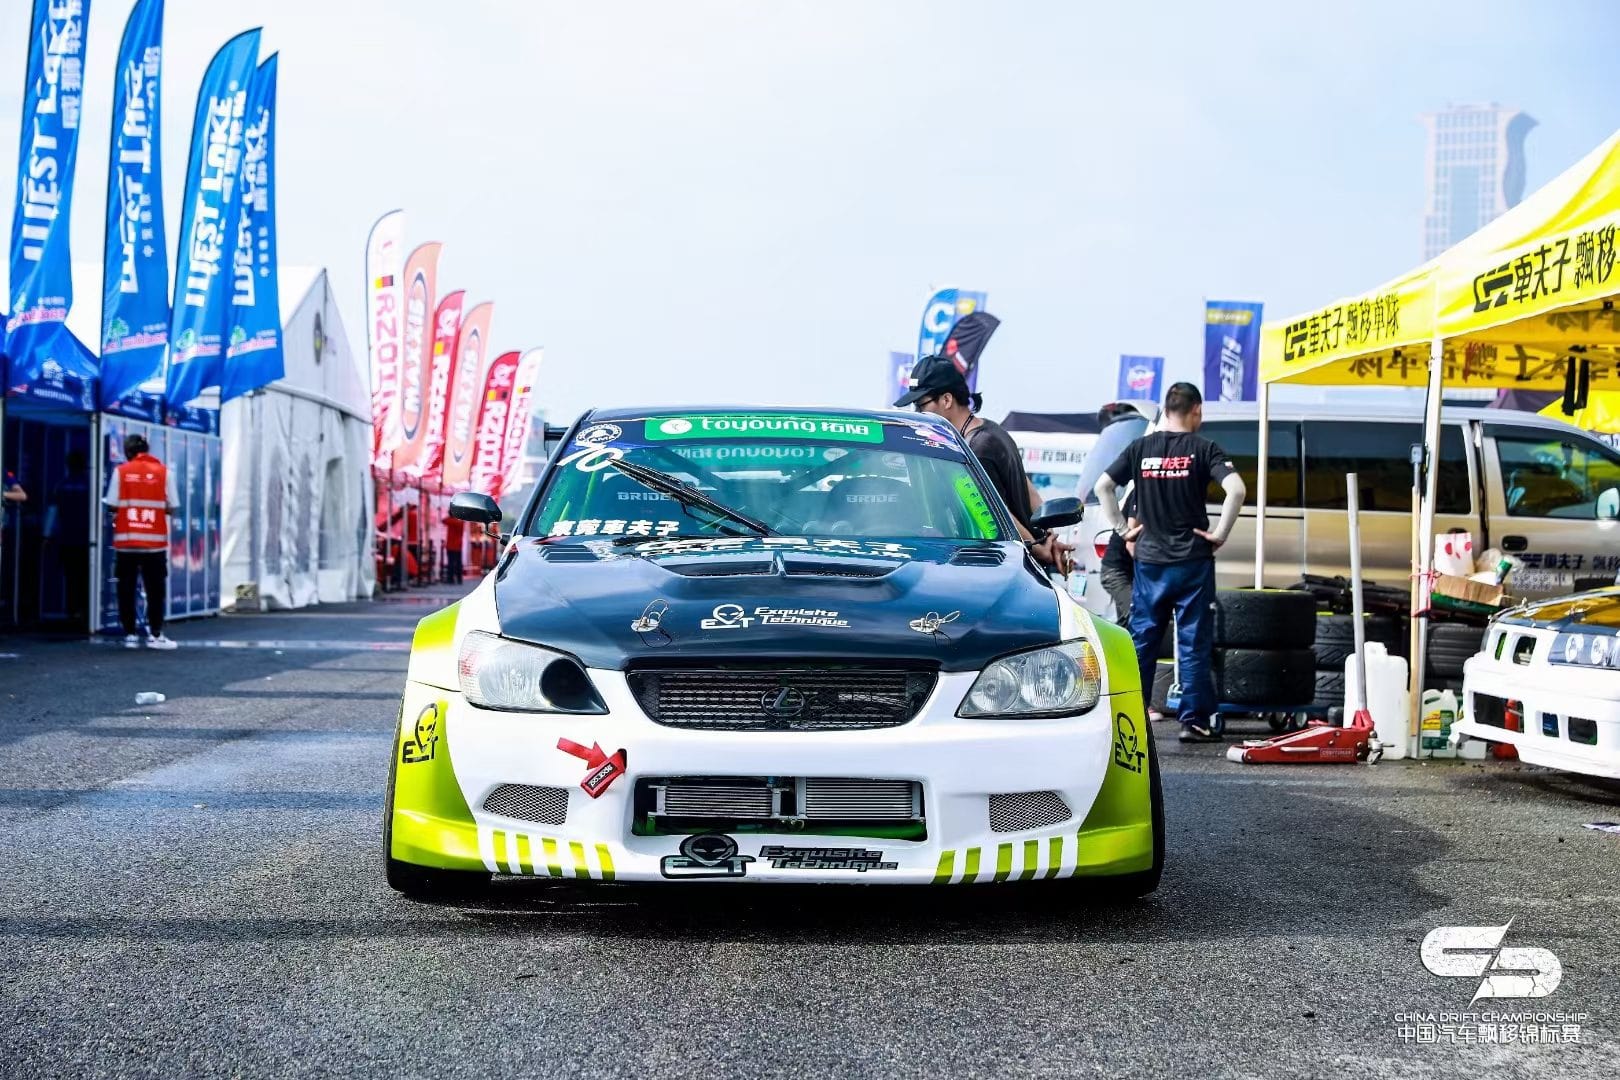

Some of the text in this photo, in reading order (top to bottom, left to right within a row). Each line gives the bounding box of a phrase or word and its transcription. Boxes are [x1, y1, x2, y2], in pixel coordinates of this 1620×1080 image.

[200, 96, 233, 191] LAKE
[184, 191, 221, 307] WEST
[403, 298, 426, 413] MAXXIS
[701, 418, 817, 433] toyoung
[617, 491, 671, 501] BRIDE
[846, 494, 898, 503] BRIDE
[754, 606, 839, 617] Exquisite
[759, 614, 851, 628] Technique
[759, 846, 883, 862] Exquisite
[767, 857, 899, 872] Technique
